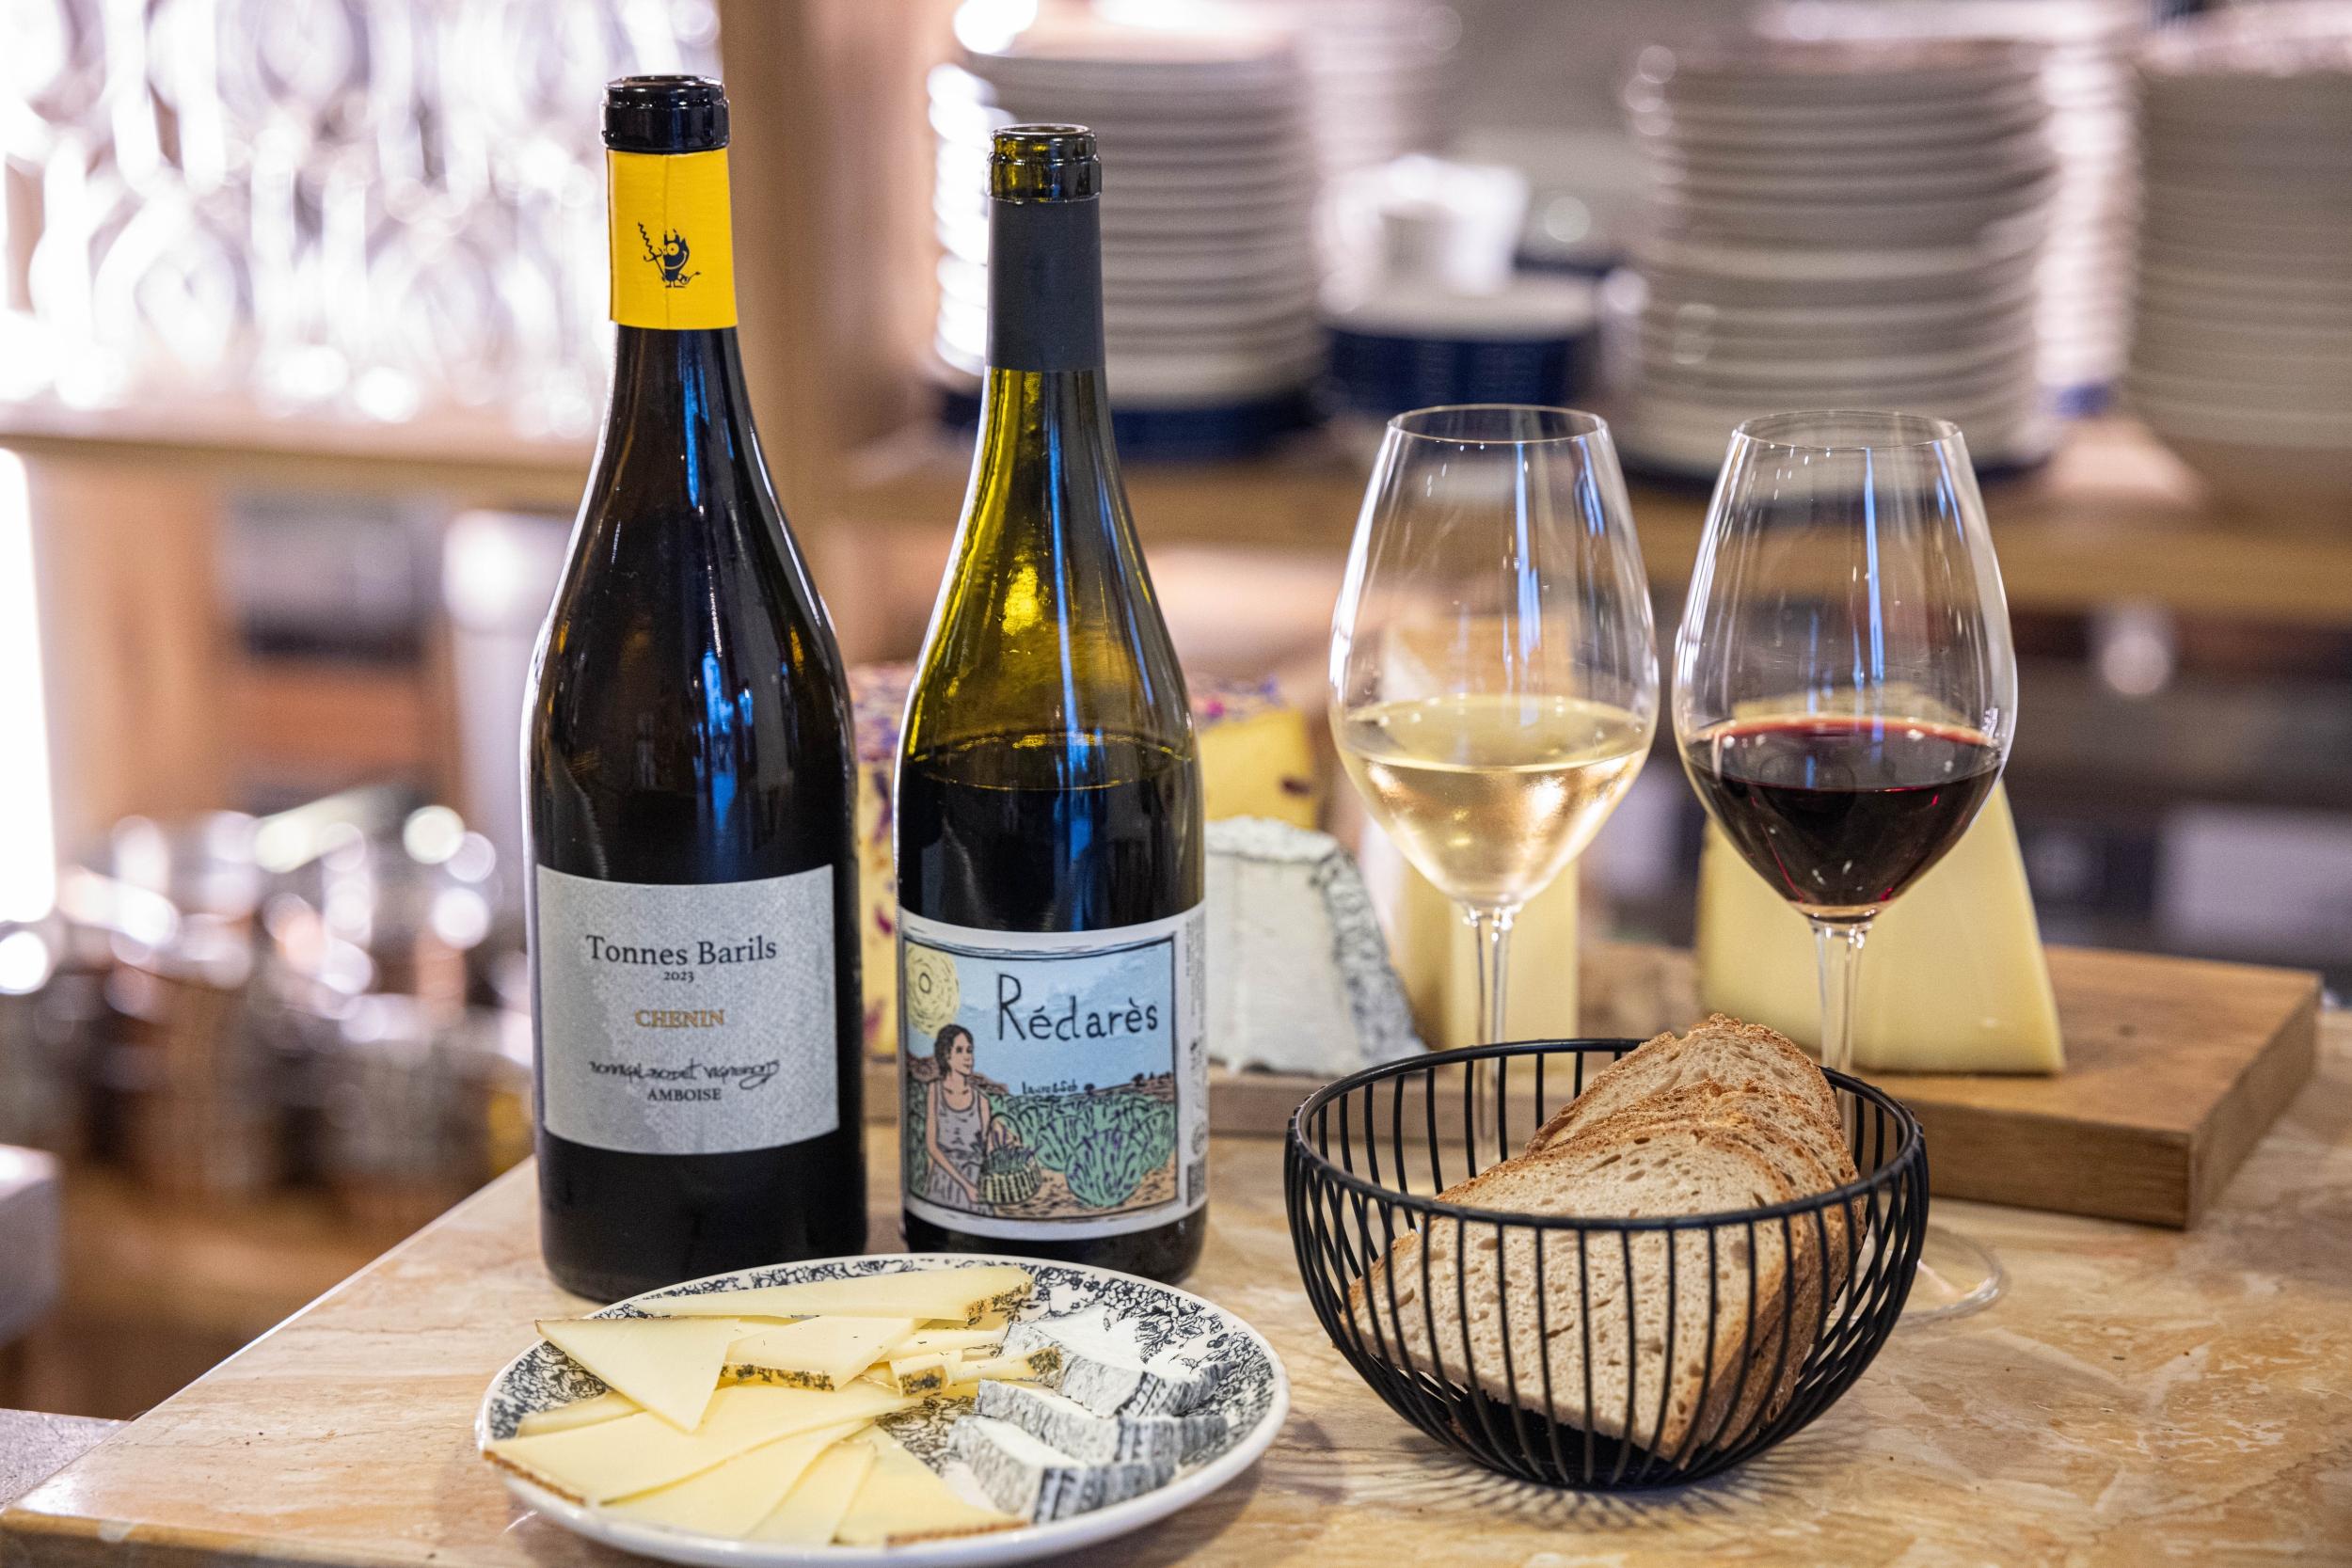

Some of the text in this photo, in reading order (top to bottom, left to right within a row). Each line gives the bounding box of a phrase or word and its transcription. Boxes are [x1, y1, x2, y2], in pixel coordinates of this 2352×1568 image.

[586, 935, 777, 965] Tonnes Barils
[663, 971, 694, 983] 2023
[634, 1008, 724, 1028] CHENIN
[647, 1087, 722, 1101] AMBOISE
